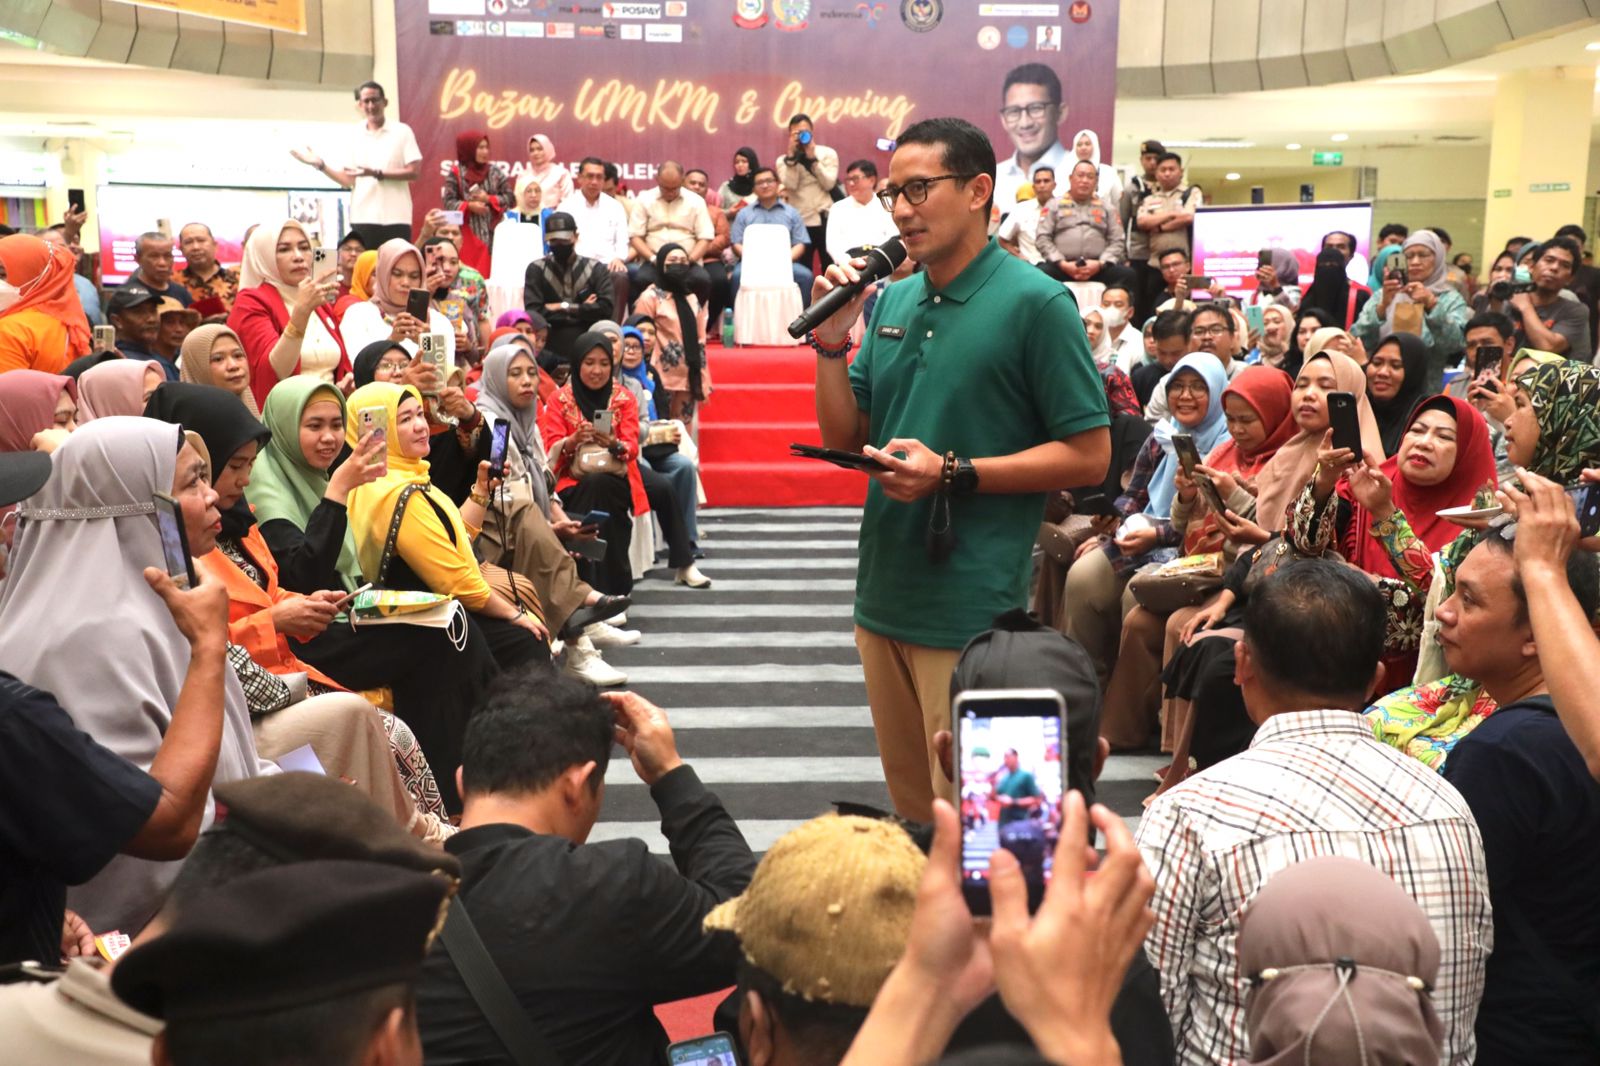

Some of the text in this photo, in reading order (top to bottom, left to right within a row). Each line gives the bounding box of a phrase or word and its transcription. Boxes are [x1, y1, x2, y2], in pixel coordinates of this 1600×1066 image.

[621, 6, 660, 16] POSPAY
[440, 67, 915, 139] Bazar UMKM & Opening
